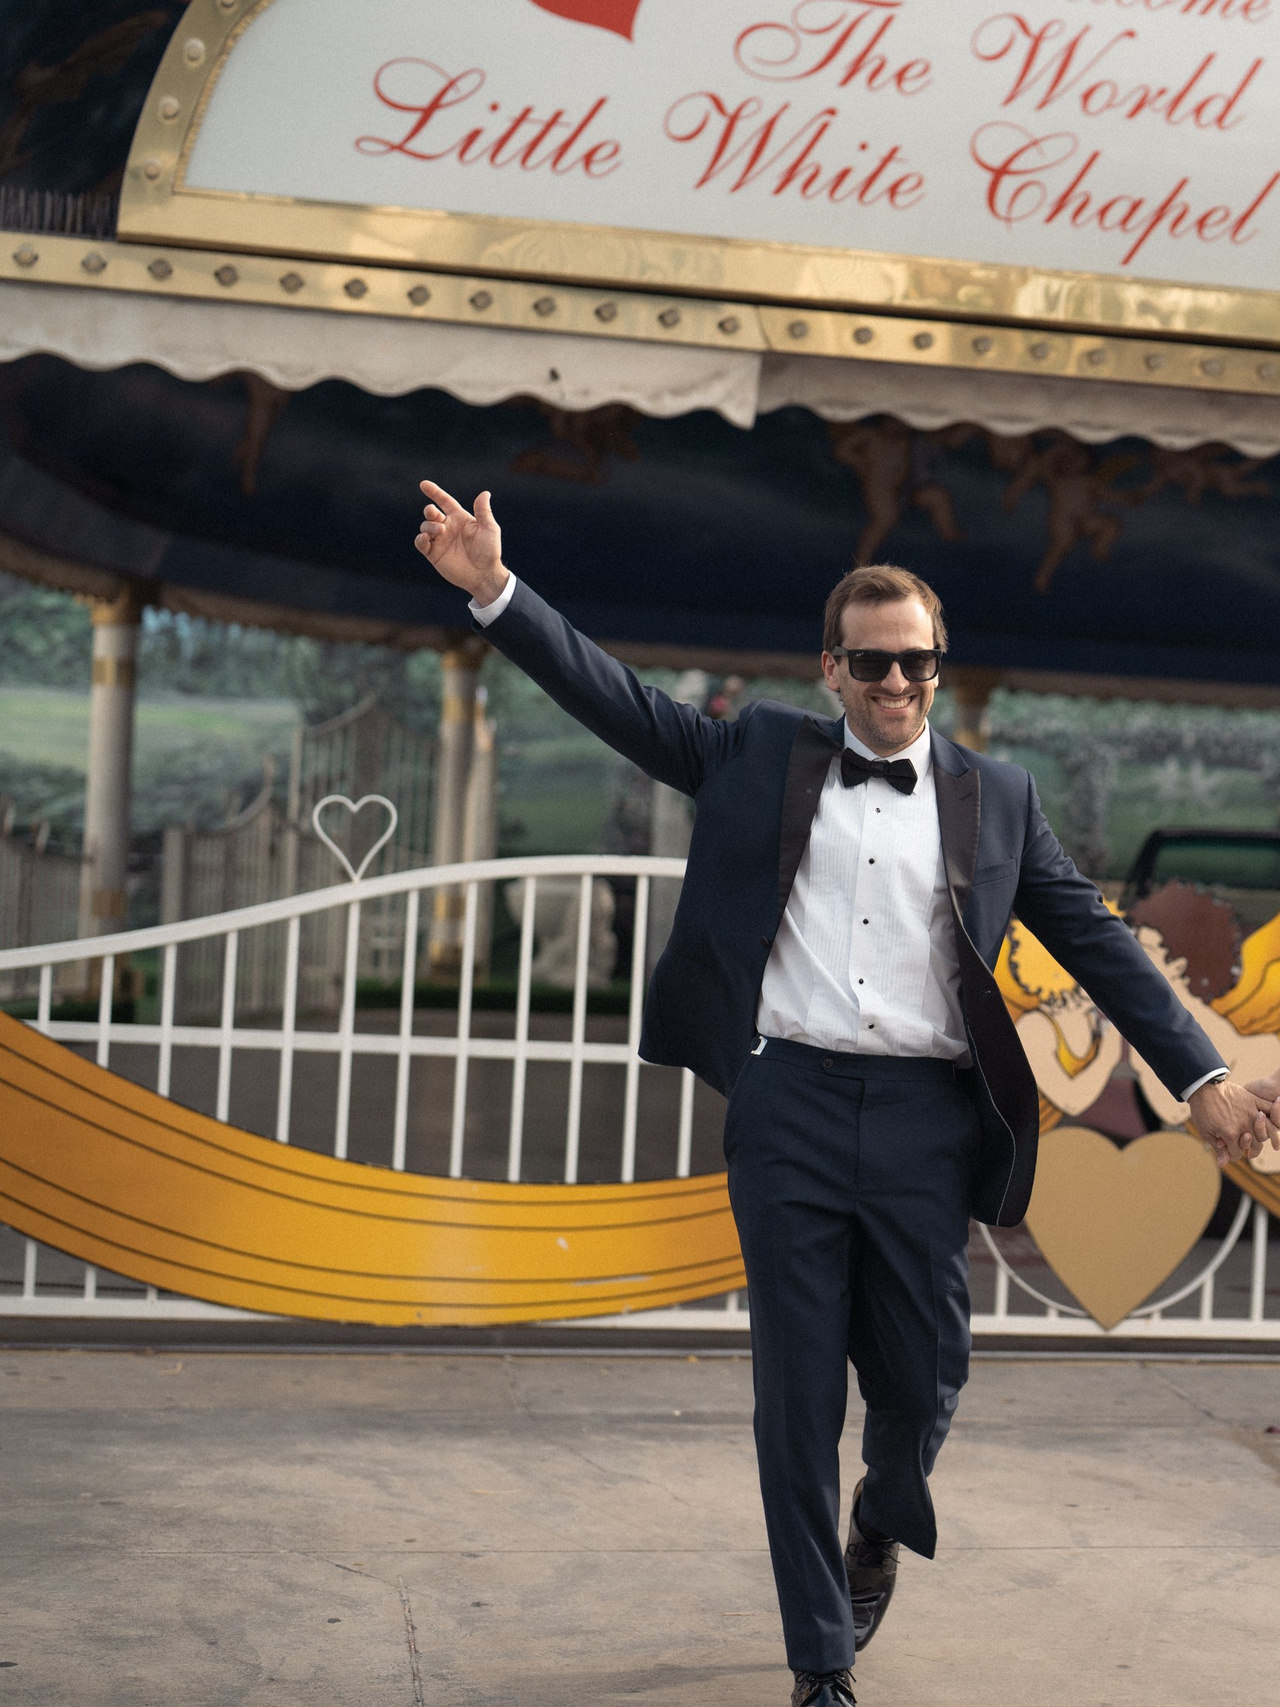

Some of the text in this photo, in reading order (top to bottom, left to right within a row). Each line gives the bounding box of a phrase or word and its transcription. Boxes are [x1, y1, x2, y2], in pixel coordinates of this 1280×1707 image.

[354, 56, 624, 180] Little
[663, 91, 926, 211] White
[733, 0, 933, 97] The
[970, 11, 1265, 132] World
